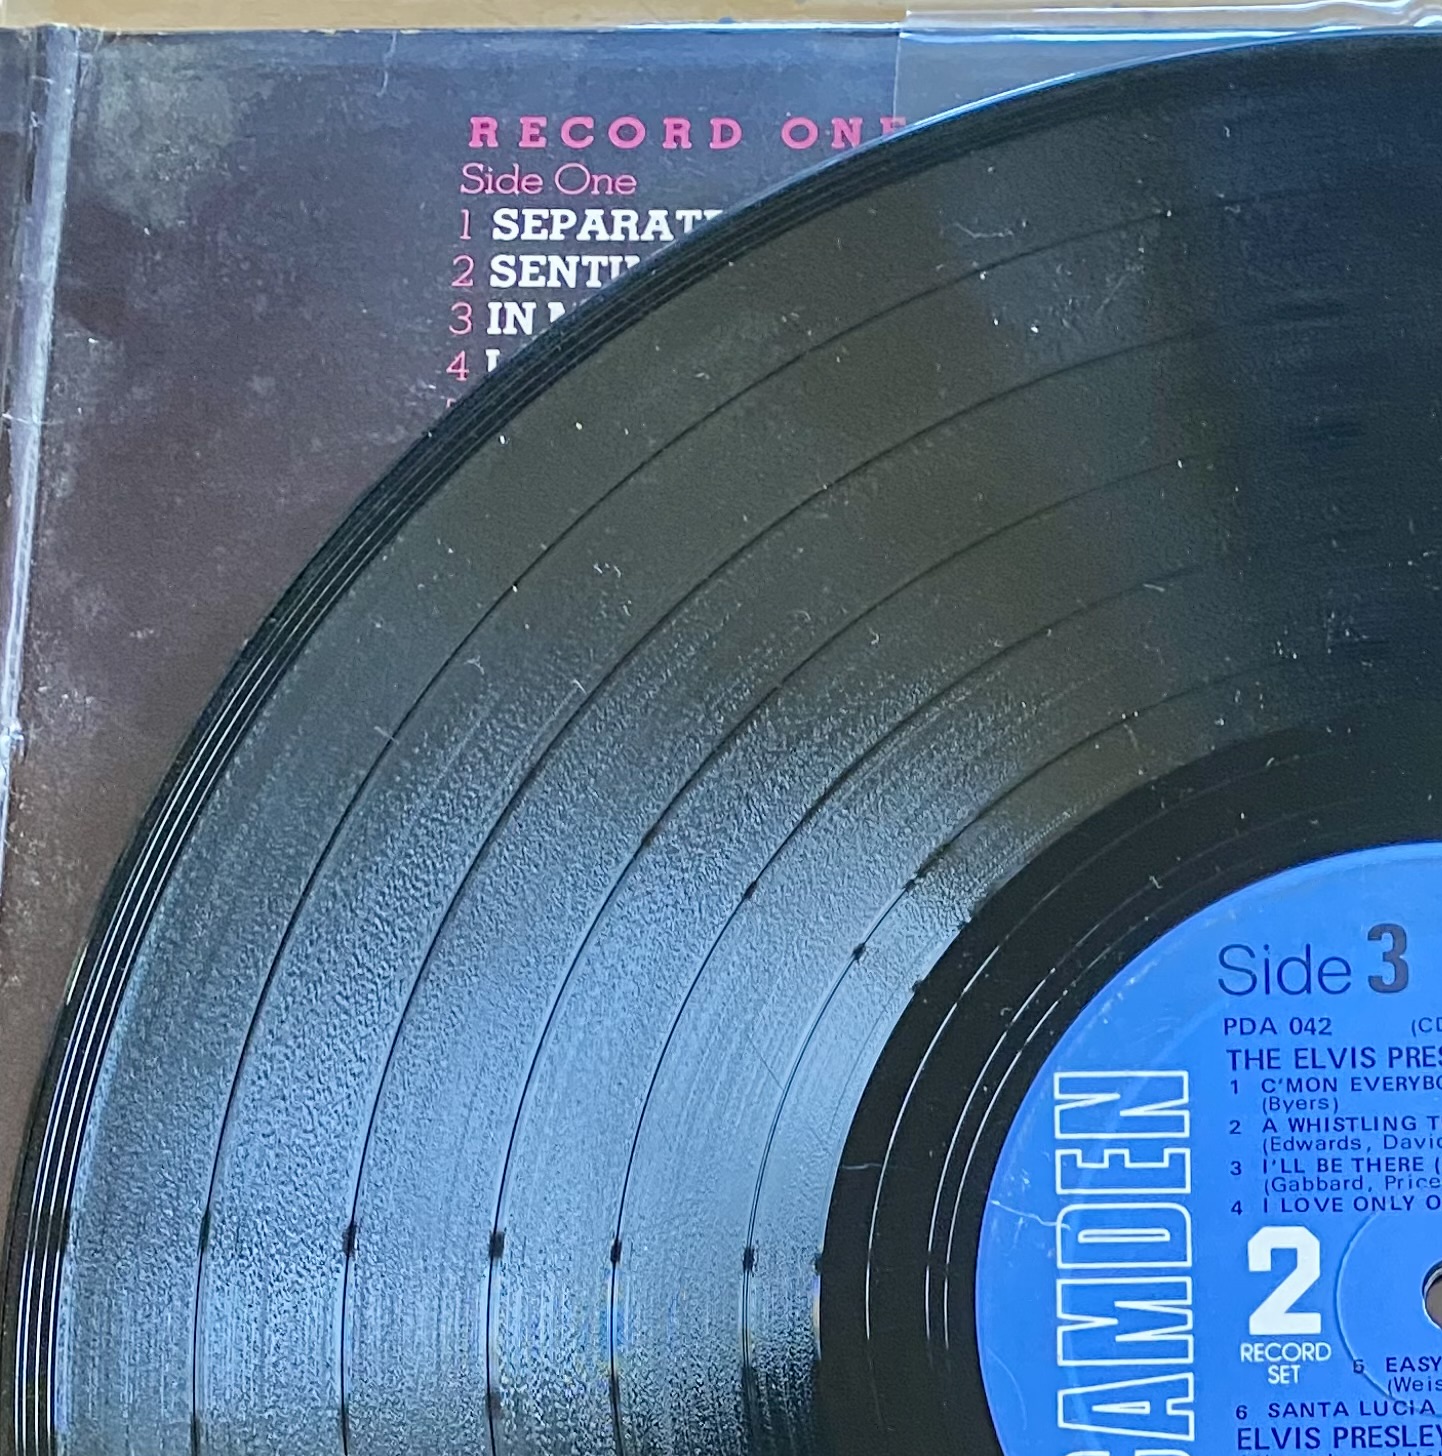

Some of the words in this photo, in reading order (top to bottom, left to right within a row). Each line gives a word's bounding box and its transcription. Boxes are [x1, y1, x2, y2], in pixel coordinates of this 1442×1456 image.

[468, 116, 742, 149] RECORD
[461, 163, 543, 195] Side
[555, 163, 637, 195] One
[451, 255, 474, 288] 2
[449, 302, 472, 334] 3
[486, 302, 536, 335] IN
[446, 350, 469, 381] 4
[1217, 942, 1351, 995] Side
[1367, 922, 1409, 994] 3
[1223, 1016, 1277, 1036] PDA
[1289, 1016, 1333, 1036] 042
[1226, 1048, 1281, 1071] THE
[1294, 1046, 1376, 1070] ELVIS
[1261, 1077, 1338, 1094] C'MON
[1261, 1096, 1339, 1115] (Byers)
[1229, 1119, 1242, 1135] 2
[1288, 1115, 1417, 1132] WHISTLING
[1262, 1136, 1372, 1153] (Edwards,
[1262, 1158, 1305, 1175] I'LL
[1316, 1157, 1343, 1173] BE
[1356, 1156, 1424, 1173] THERE
[1263, 1176, 1372, 1195] (Gabbard,
[1281, 1197, 1343, 1213] LOVE
[1353, 1195, 1415, 1212] ONLY
[1247, 1225, 1322, 1336] 2
[1240, 1342, 1331, 1363] RECORD
[1267, 1364, 1301, 1384] SET
[1386, 1356, 1442, 1374] EASY
[1268, 1401, 1349, 1418] SANTA
[1360, 1399, 1436, 1416] LUCIA
[1237, 1426, 1321, 1450] ELVIS
